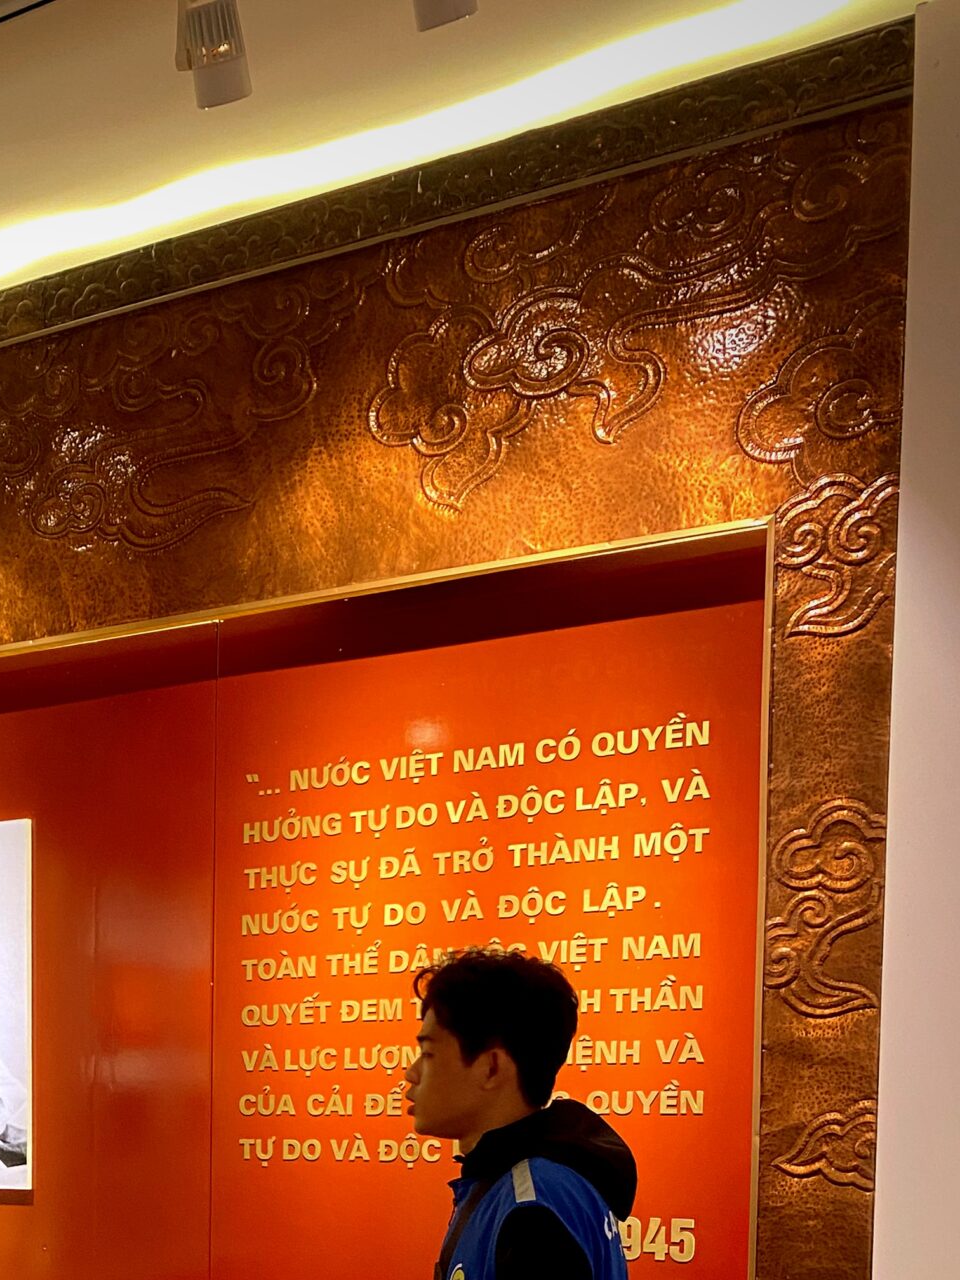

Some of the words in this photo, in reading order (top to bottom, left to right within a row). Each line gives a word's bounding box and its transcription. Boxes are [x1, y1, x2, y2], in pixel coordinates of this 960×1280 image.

[290, 758, 371, 791] NƯỚC
[379, 748, 444, 784] VIỆT
[453, 742, 525, 773] NAM
[535, 728, 581, 763] CÓ
[591, 712, 710, 757] QUYỀN
[243, 807, 343, 844] HƯỞNG
[349, 804, 390, 838] TỰ
[395, 802, 438, 829] DO
[445, 791, 489, 823] VÀ
[495, 785, 566, 823] ĐỘC
[575, 778, 647, 815] LẬP,
[661, 768, 711, 803] VÀ
[244, 861, 318, 893] THỰC
[330, 856, 371, 889] SỰ
[378, 847, 421, 879] ĐÃ
[432, 836, 494, 875] TRỞ
[507, 832, 620, 867] THÀNH
[633, 822, 710, 862] MỘT
[241, 902, 320, 936] NƯỚC
[332, 902, 372, 935] TỰ
[383, 901, 426, 926] DO
[440, 889, 484, 922] VÀ
[497, 886, 567, 924] ĐỘC
[241, 950, 317, 981] TOÀN
[325, 939, 382, 976] THỂ
[537, 931, 609, 971] VIỆT
[622, 933, 701, 960] NAM
[241, 991, 331, 1026] QUYẾT
[339, 998, 403, 1022] ĐEM
[609, 974, 703, 1012] THẦN
[241, 1044, 279, 1071] VÀ
[284, 1046, 338, 1077] LỰC
[343, 1043, 422, 1075] LƯỢN
[565, 1034, 641, 1071] ỆNH
[655, 1032, 705, 1063] VÀ
[239, 1085, 297, 1116] CỦA
[306, 1084, 353, 1116] CẢI
[363, 1080, 407, 1115] ĐỂ
[585, 1079, 704, 1118] QUYỀN
[238, 1135, 276, 1167] TỰ
[282, 1138, 322, 1161] DO
[330, 1132, 371, 1161] VÀ
[377, 1132, 442, 1168] ĐỘC
[618, 1216, 696, 1263] 945
